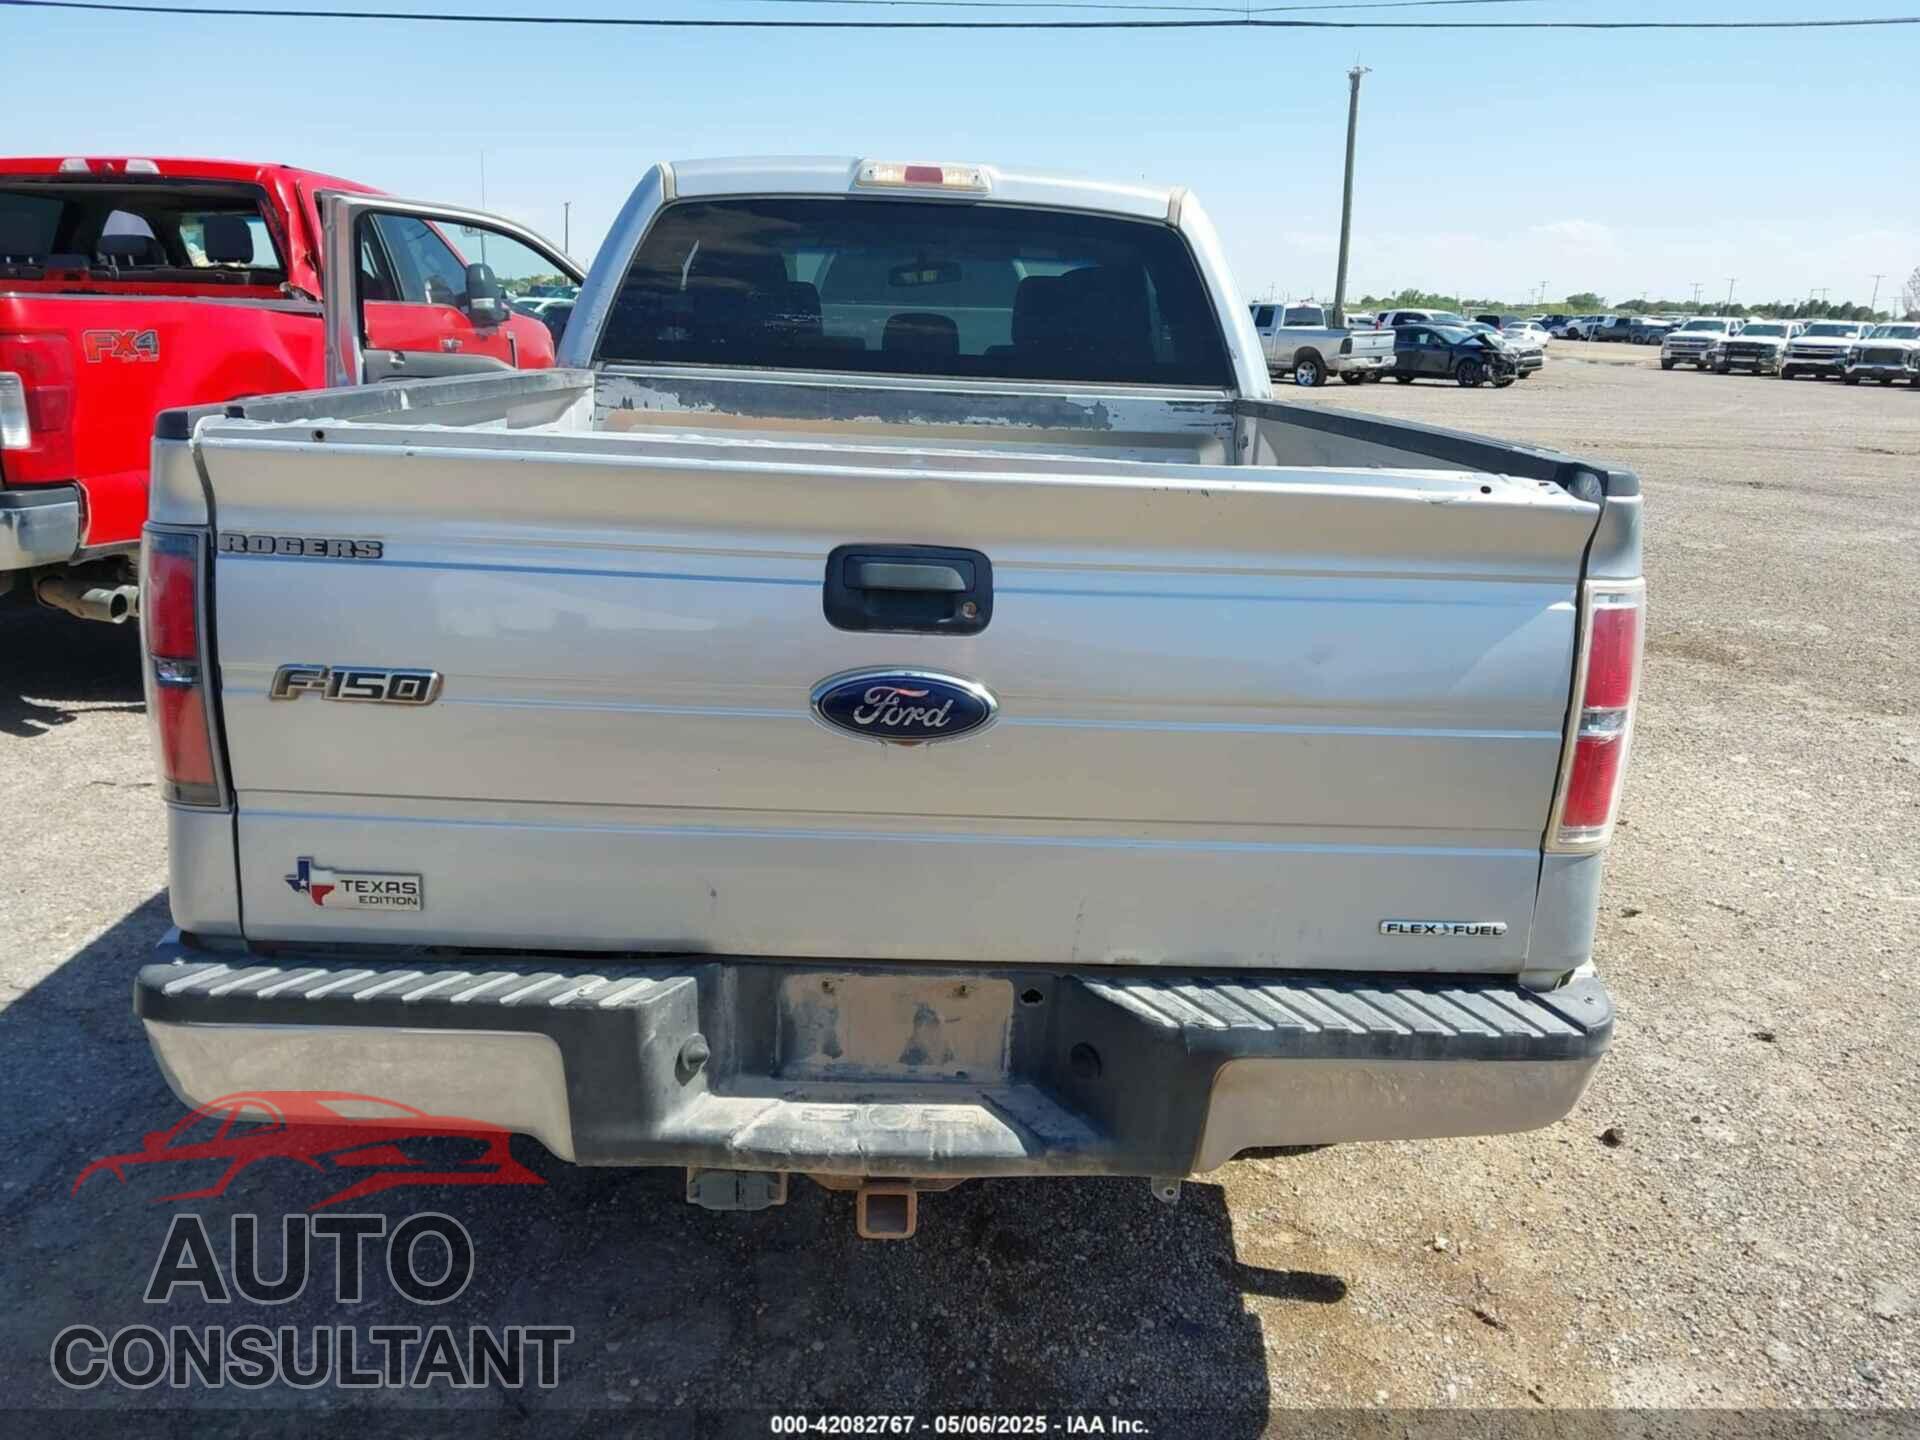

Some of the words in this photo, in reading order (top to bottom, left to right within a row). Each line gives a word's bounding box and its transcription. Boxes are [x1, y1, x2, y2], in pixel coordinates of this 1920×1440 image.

[83, 329, 160, 363] FX4
[219, 533, 384, 559] ROGERS
[269, 664, 443, 705] F-150
[853, 686, 954, 728] Ford
[341, 880, 417, 894] TEXAS
[359, 895, 417, 905] EDITION
[1387, 924, 1436, 934] FLEX
[1453, 925, 1502, 935] FUEL
